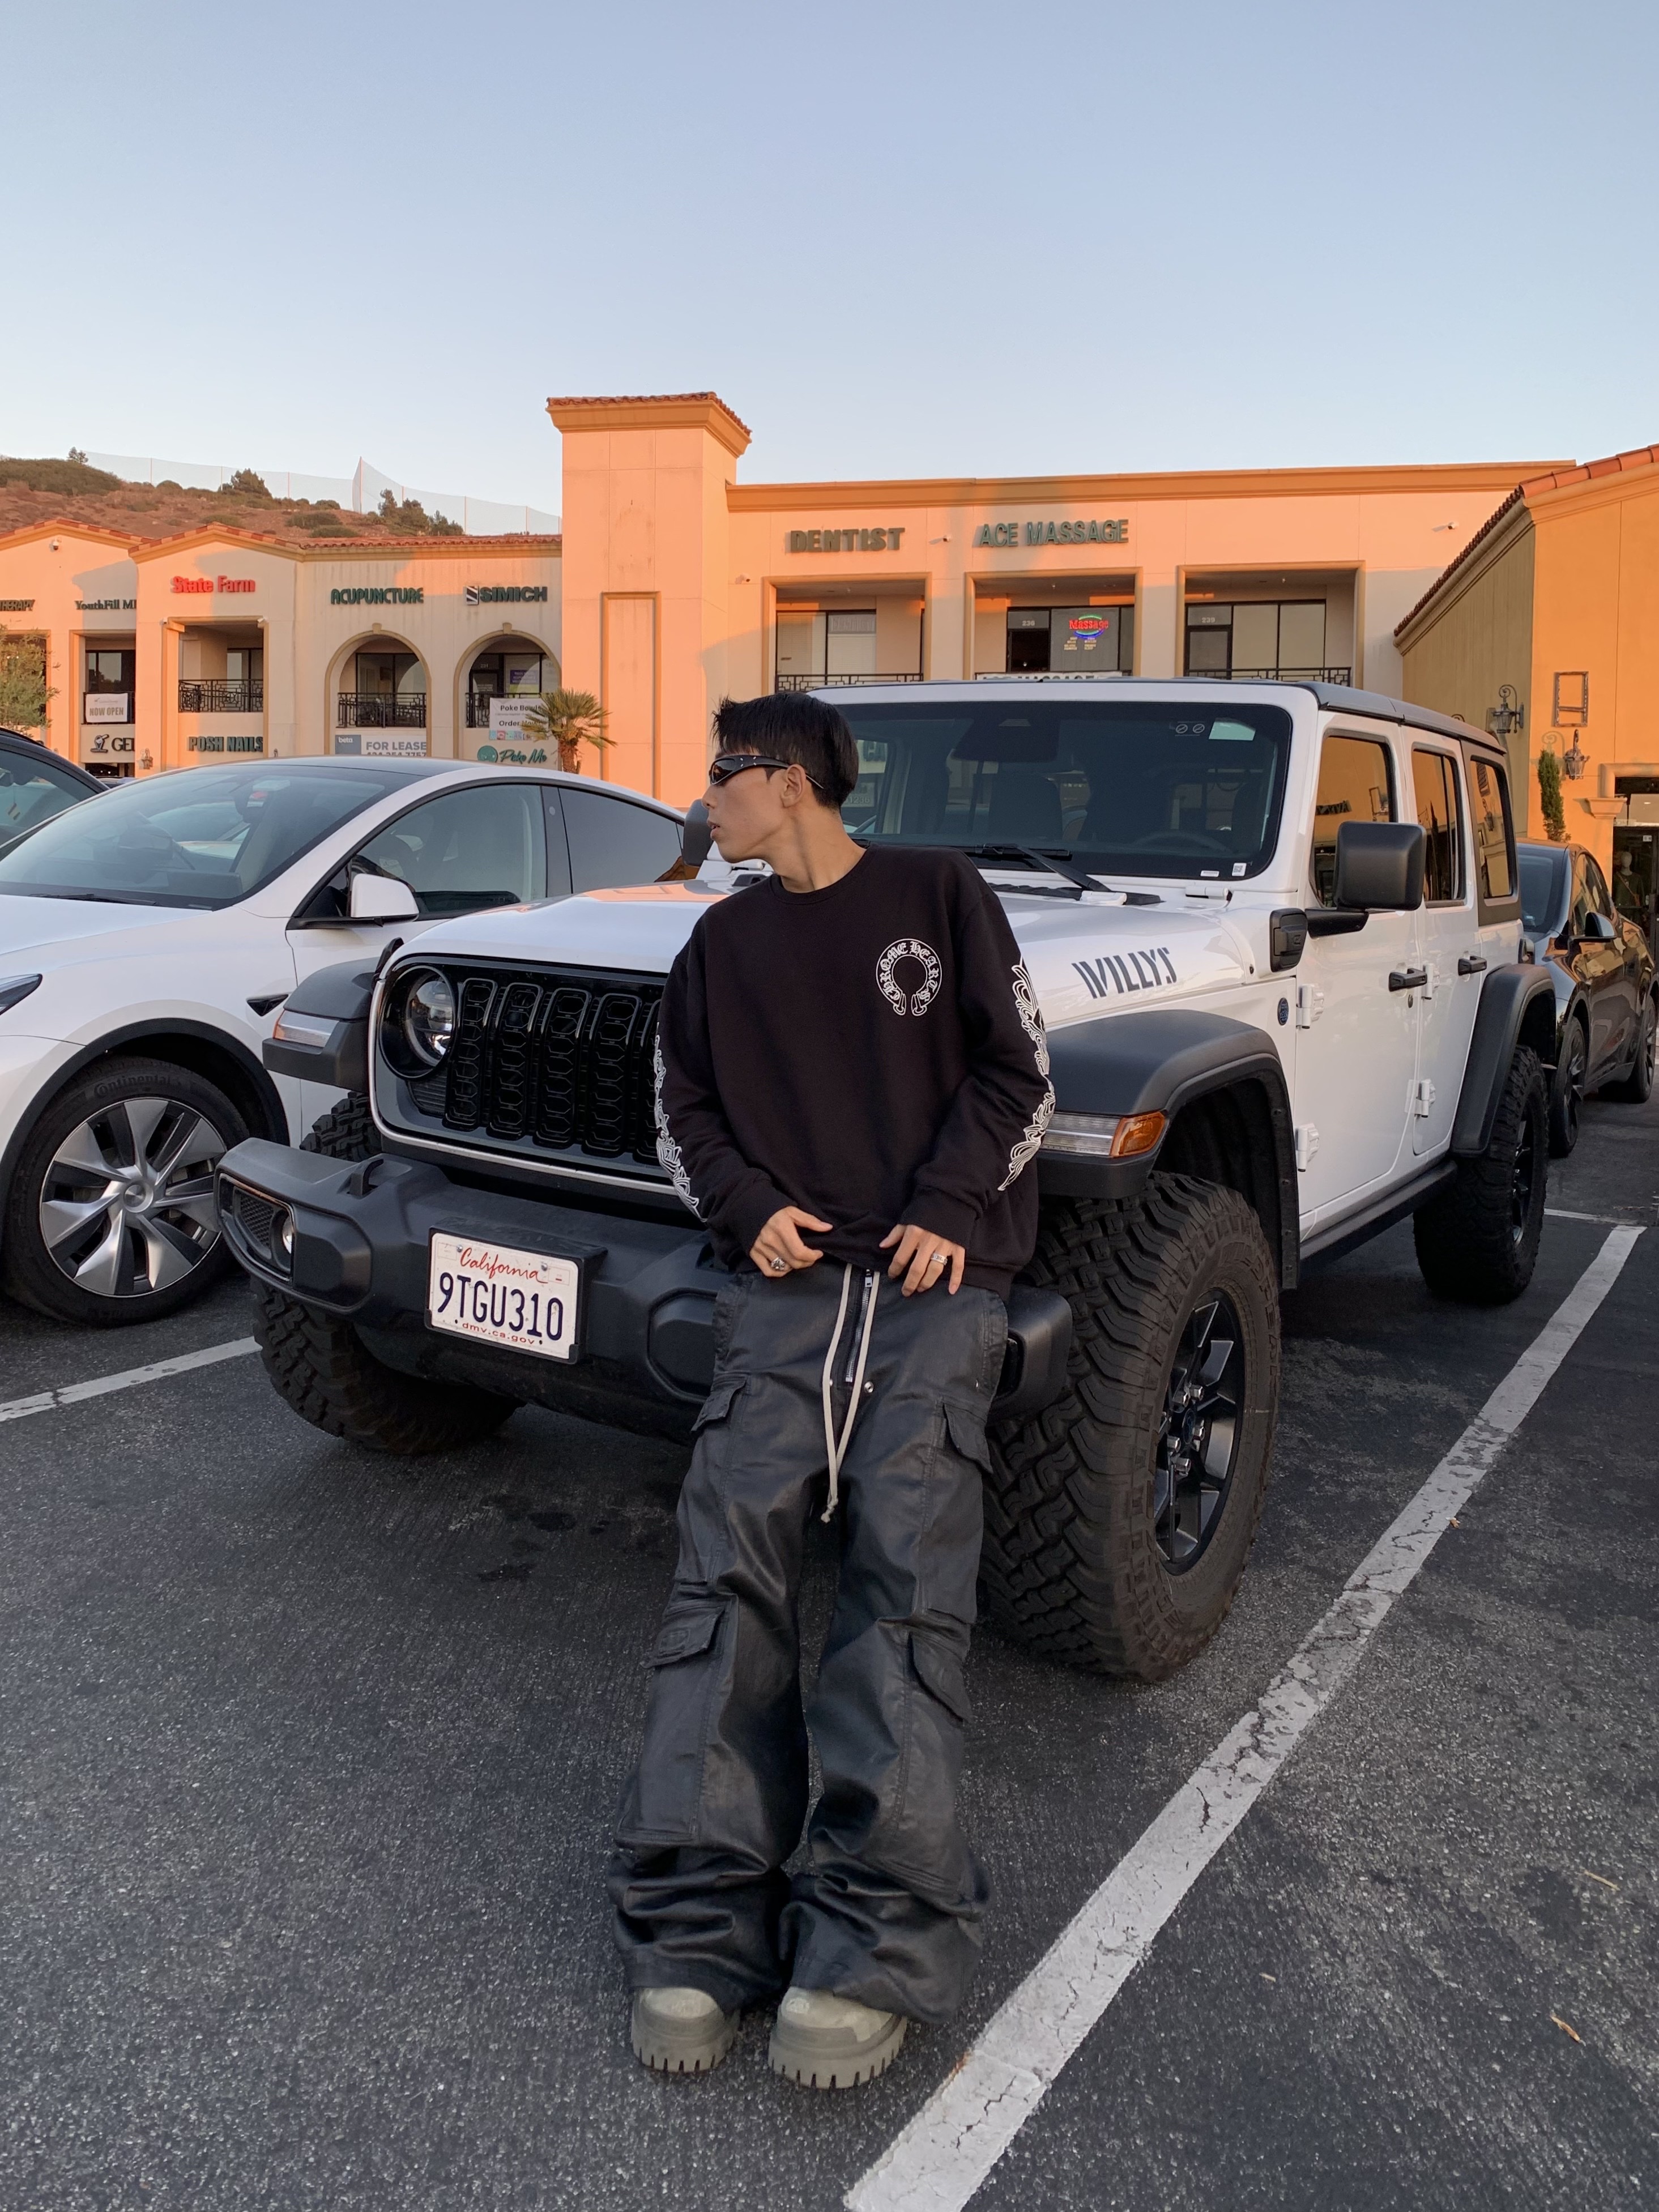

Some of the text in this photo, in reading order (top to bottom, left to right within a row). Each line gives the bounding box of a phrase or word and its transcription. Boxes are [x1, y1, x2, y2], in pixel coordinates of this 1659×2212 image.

[790, 527, 906, 553] DENTIST
[979, 519, 1129, 547] ACE MASSAGE
[172, 575, 256, 593] State Farm
[330, 587, 424, 604] ACUPUNCTURE
[480, 586, 548, 602] SIMICH
[75, 599, 121, 610] YouthFill
[1069, 619, 1109, 630] Massage
[89, 707, 124, 717] NOW OPEN
[189, 736, 263, 752] POSH NAILS
[366, 741, 427, 751] FOR LEASE
[499, 749, 527, 765] Poke
[880, 941, 939, 1003] CHROME HEARTS
[1071, 947, 1178, 999] WILLYS
[93, 1074, 171, 1099] Continental
[460, 1247, 548, 1284] California
[437, 1272, 564, 1341] 9TGU310
[462, 1322, 535, 1345] dmv.ca.gov
